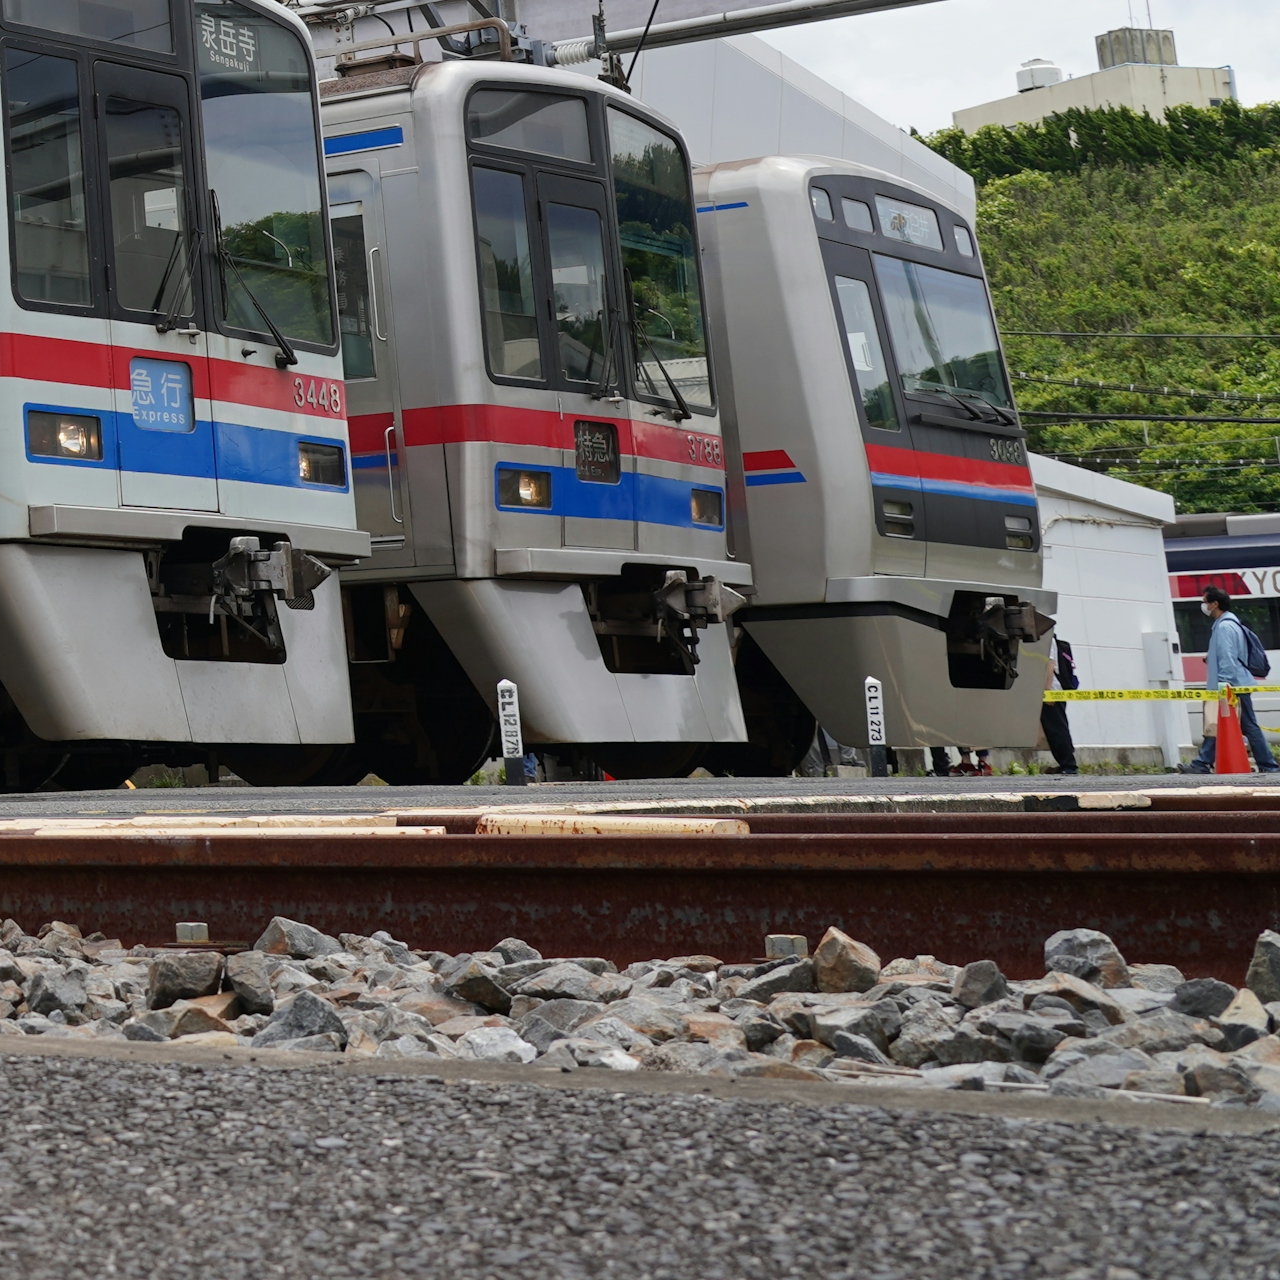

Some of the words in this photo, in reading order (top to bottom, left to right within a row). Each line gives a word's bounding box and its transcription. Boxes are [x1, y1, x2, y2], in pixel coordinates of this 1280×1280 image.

[200, 12, 256, 62] 泉岳寺
[209, 50, 250, 73] Sengakuji
[130, 368, 183, 409] 急行
[294, 377, 341, 413] 3448
[132, 406, 186, 425] Express
[576, 430, 610, 463] 特急
[688, 435, 721, 465] 3788
